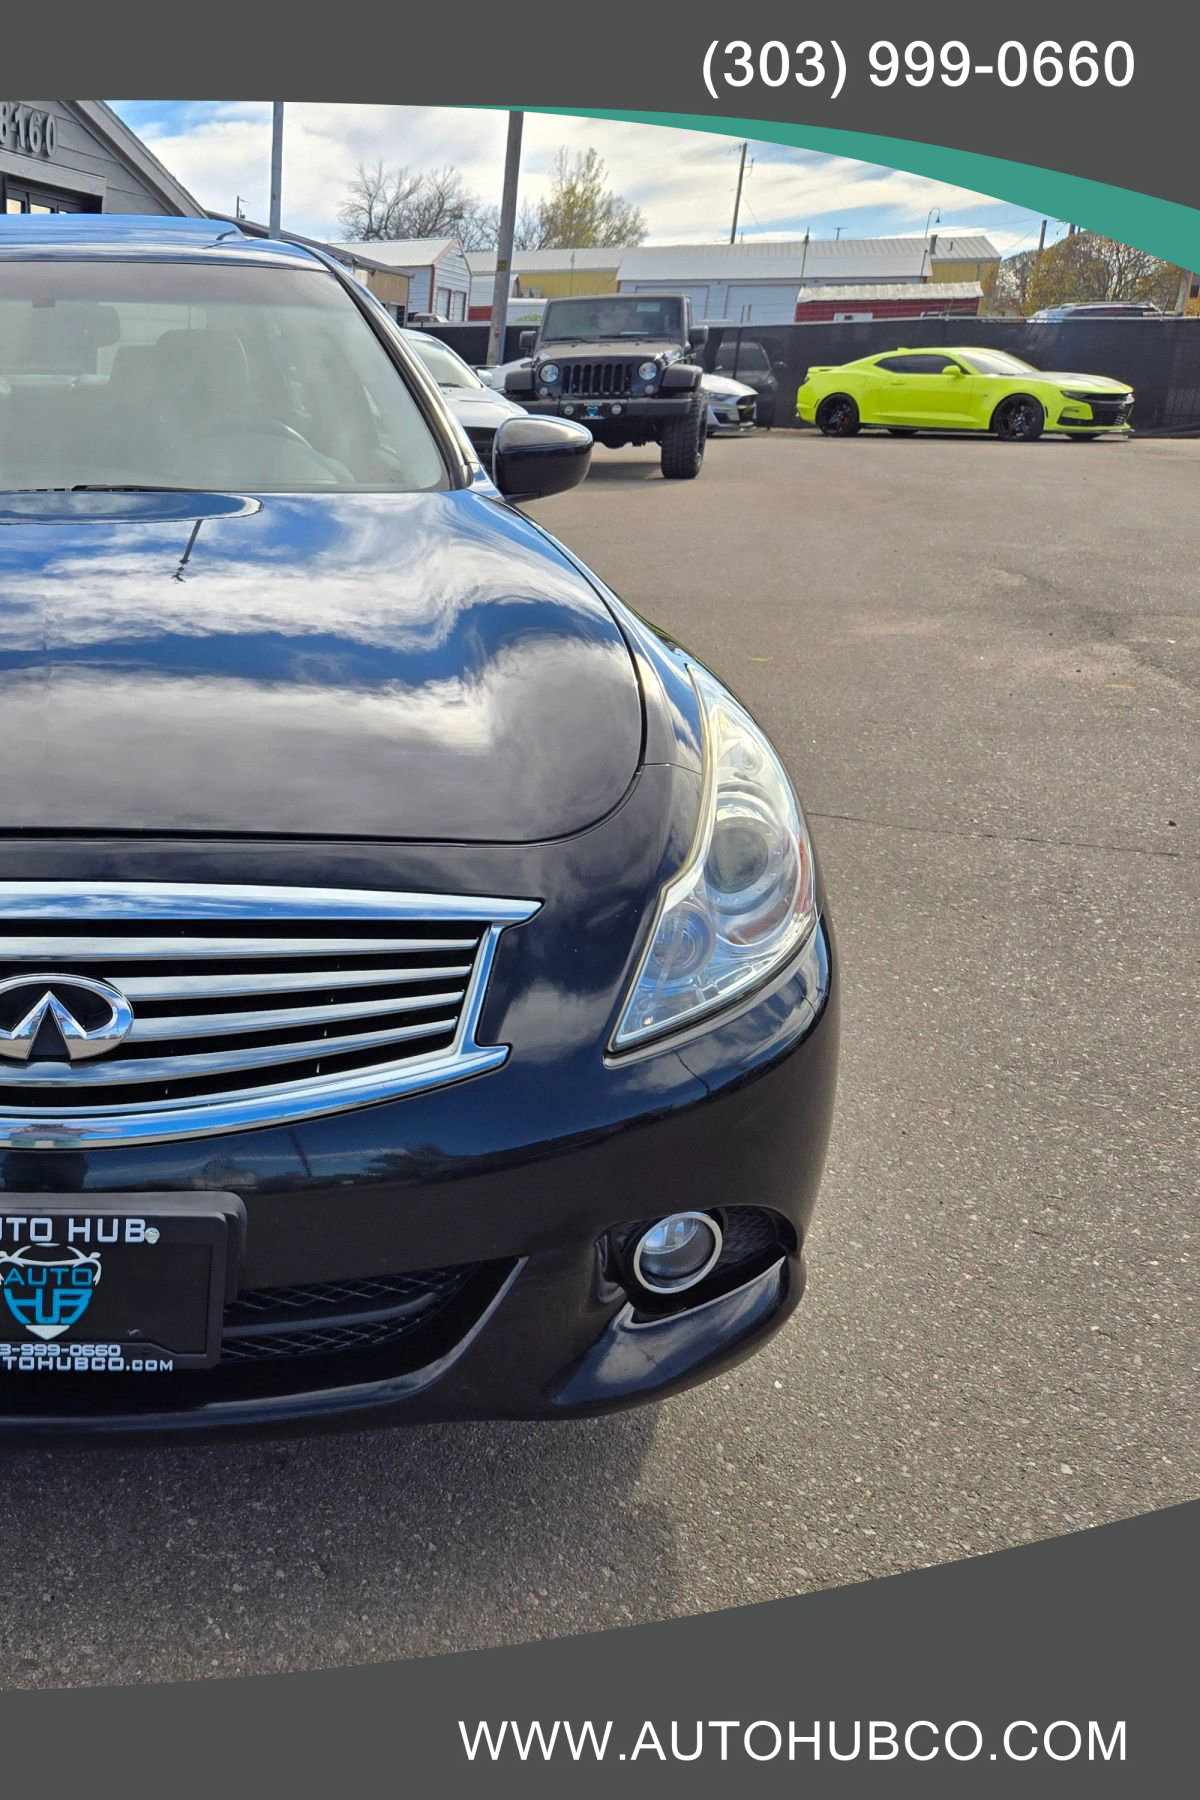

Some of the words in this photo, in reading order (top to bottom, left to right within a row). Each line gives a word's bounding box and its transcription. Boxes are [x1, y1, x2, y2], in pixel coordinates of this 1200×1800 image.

[68, 1217, 147, 1243] HUB
[3, 1267, 93, 1287] AUTO
[3, 1288, 93, 1325] HUB
